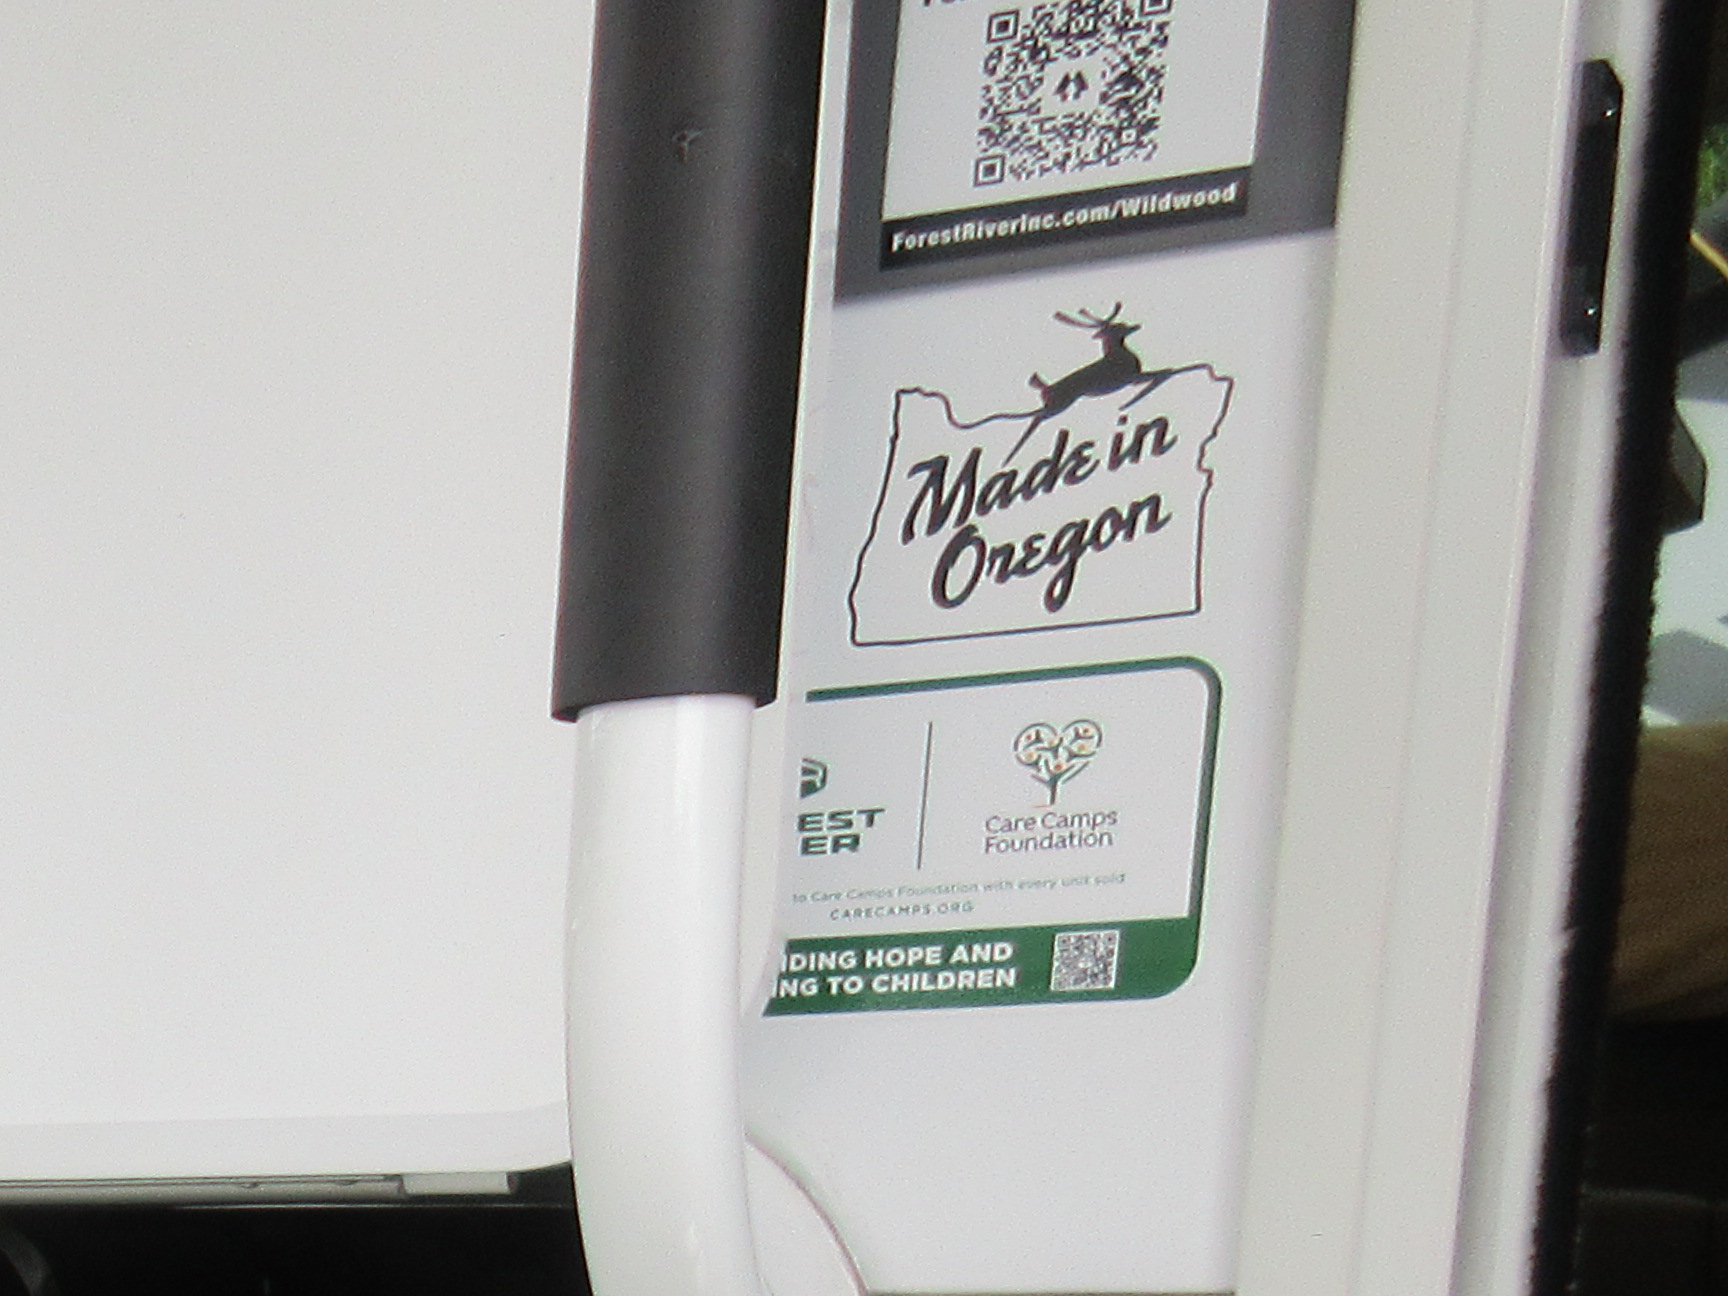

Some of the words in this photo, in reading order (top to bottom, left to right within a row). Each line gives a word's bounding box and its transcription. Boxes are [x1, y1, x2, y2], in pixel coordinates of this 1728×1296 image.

[892, 182, 1240, 252] ForestRiverInc.com/Wildwood
[900, 428, 1100, 546] Made
[1106, 414, 1179, 472] in
[930, 491, 1173, 612] Oregon
[984, 814, 1037, 834] Care
[1040, 810, 1119, 833] Camps
[984, 829, 1114, 854] Foundation
[897, 881, 979, 899] Foundation
[829, 902, 975, 921] CARECAMPS.ORG
[865, 946, 943, 968] HOPE
[949, 941, 1014, 965] AND
[826, 975, 865, 996] TO
[871, 967, 1017, 993] CHILDREN
